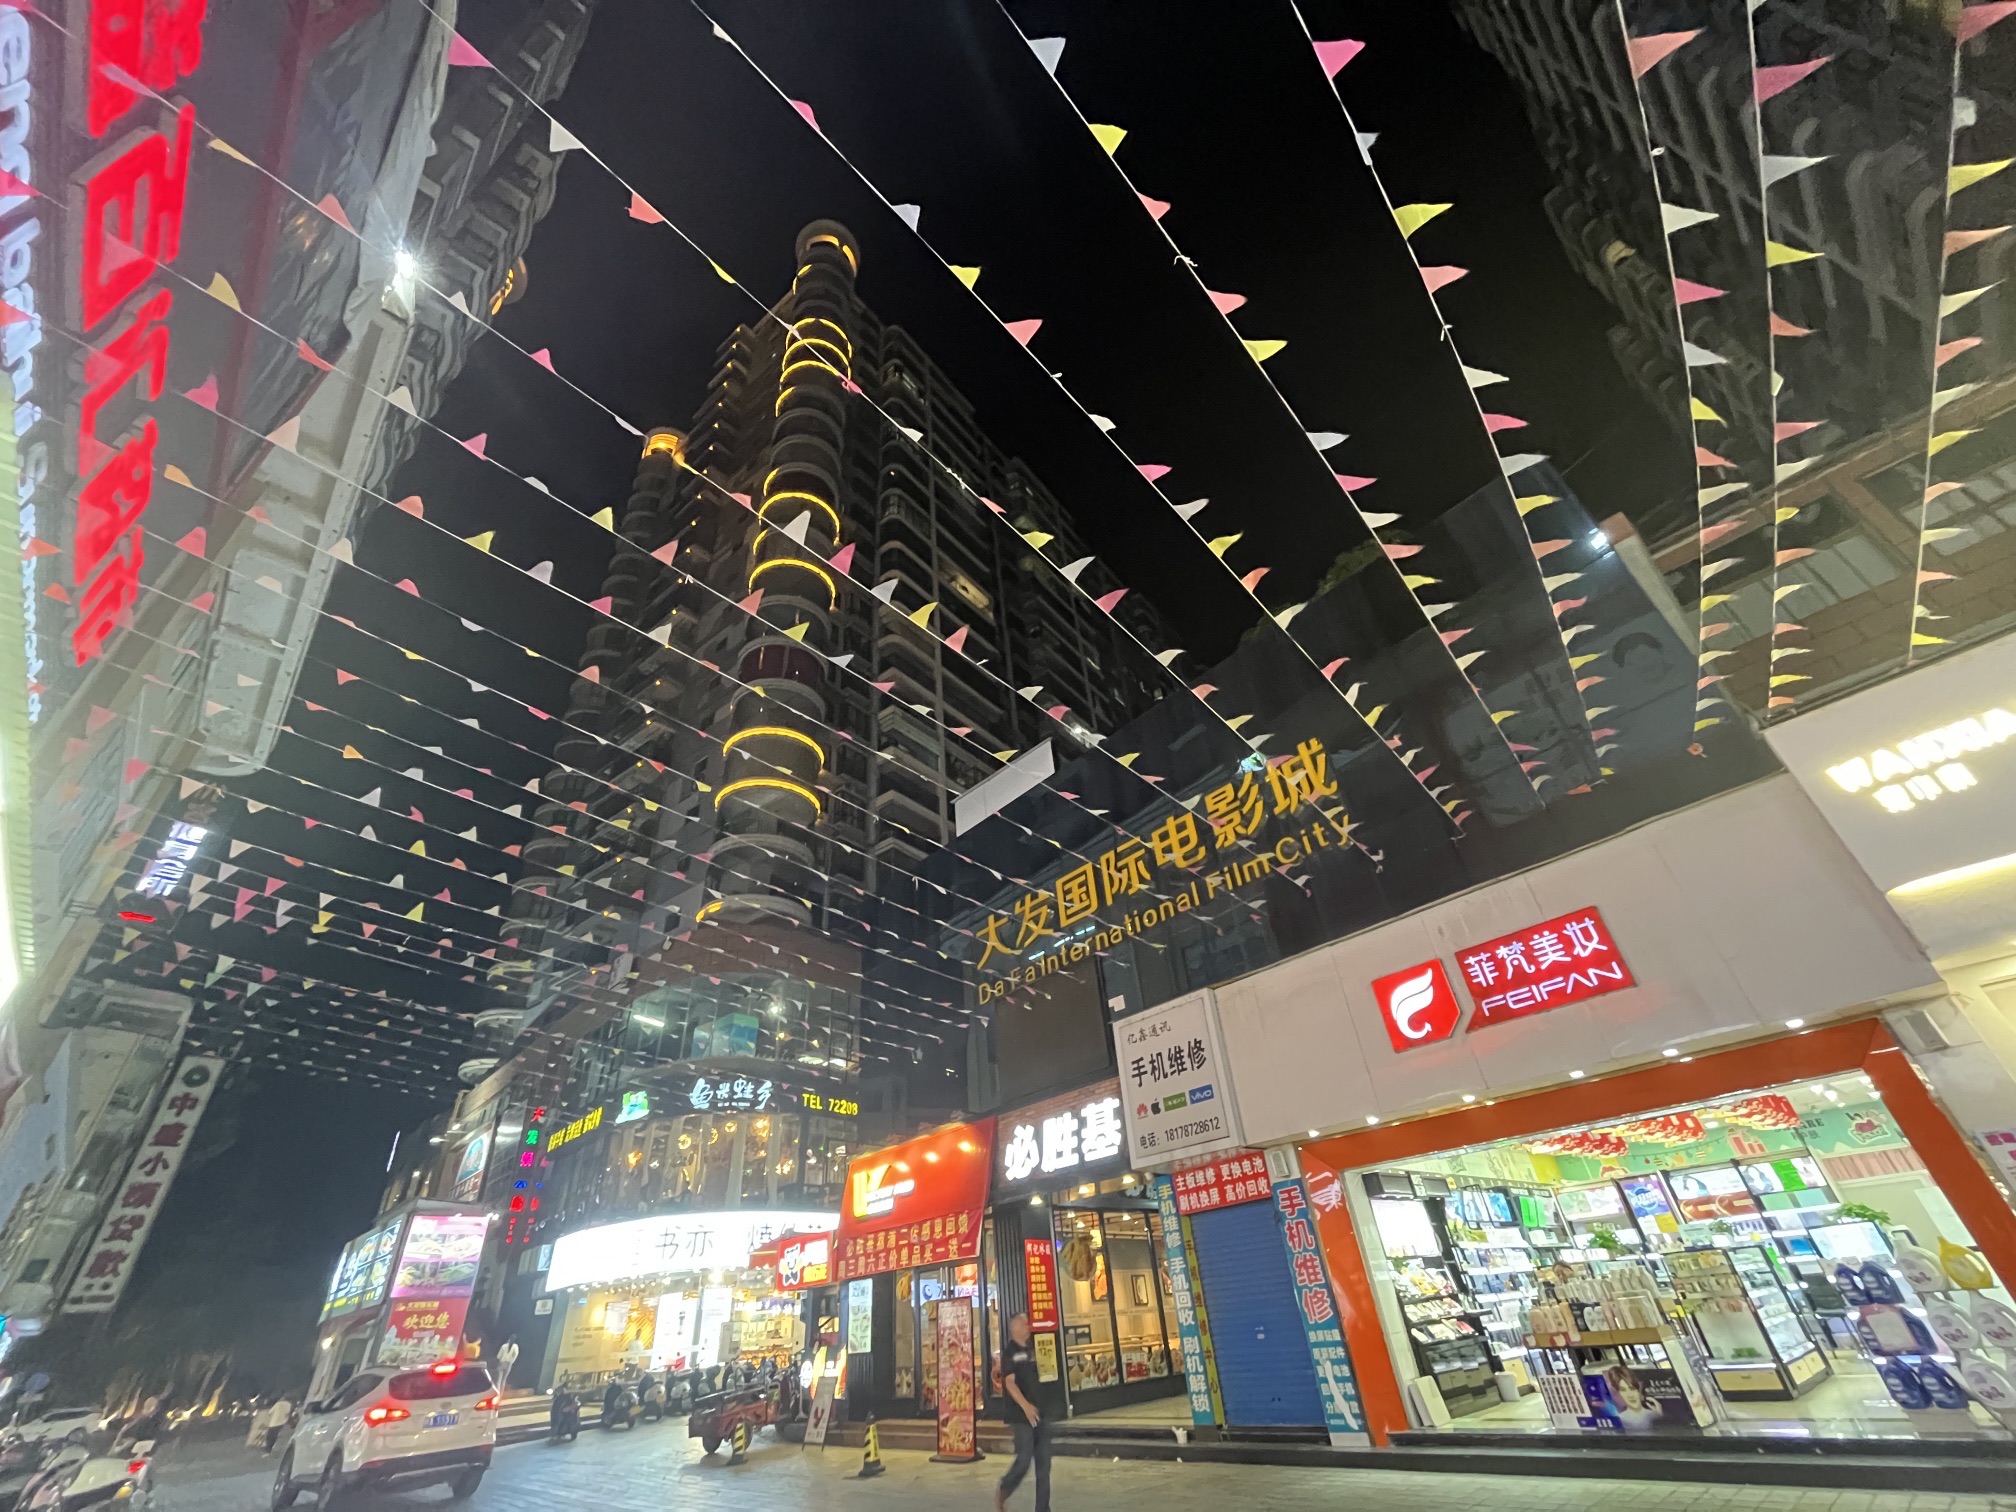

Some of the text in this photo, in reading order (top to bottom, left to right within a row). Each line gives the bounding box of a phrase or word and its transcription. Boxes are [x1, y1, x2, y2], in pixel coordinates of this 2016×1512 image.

[976, 737, 1338, 970] 大发国际电影城
[1036, 880, 1202, 977] International
[1206, 855, 1271, 900] Film
[1275, 814, 1352, 865] City
[1464, 917, 1608, 987] 菲梵美妆
[1481, 961, 1624, 1017] FEIFAN
[1127, 1020, 1171, 1045] 亿鑫通讯
[1131, 1037, 1207, 1088] 手机维修
[802, 1093, 823, 1110] TEL
[1164, 1116, 1221, 1143] 18178728612
[1004, 1097, 1122, 1181] 必胜基
[1175, 1167, 1217, 1192] 主板维修
[1219, 1156, 1265, 1182] 更换电池
[1179, 1177, 1270, 1212] 刷机换屏 高价回收
[1276, 1185, 1335, 1325] 手机维修
[1157, 1183, 1211, 1413] 手机维修 手机回收 刷机解锁
